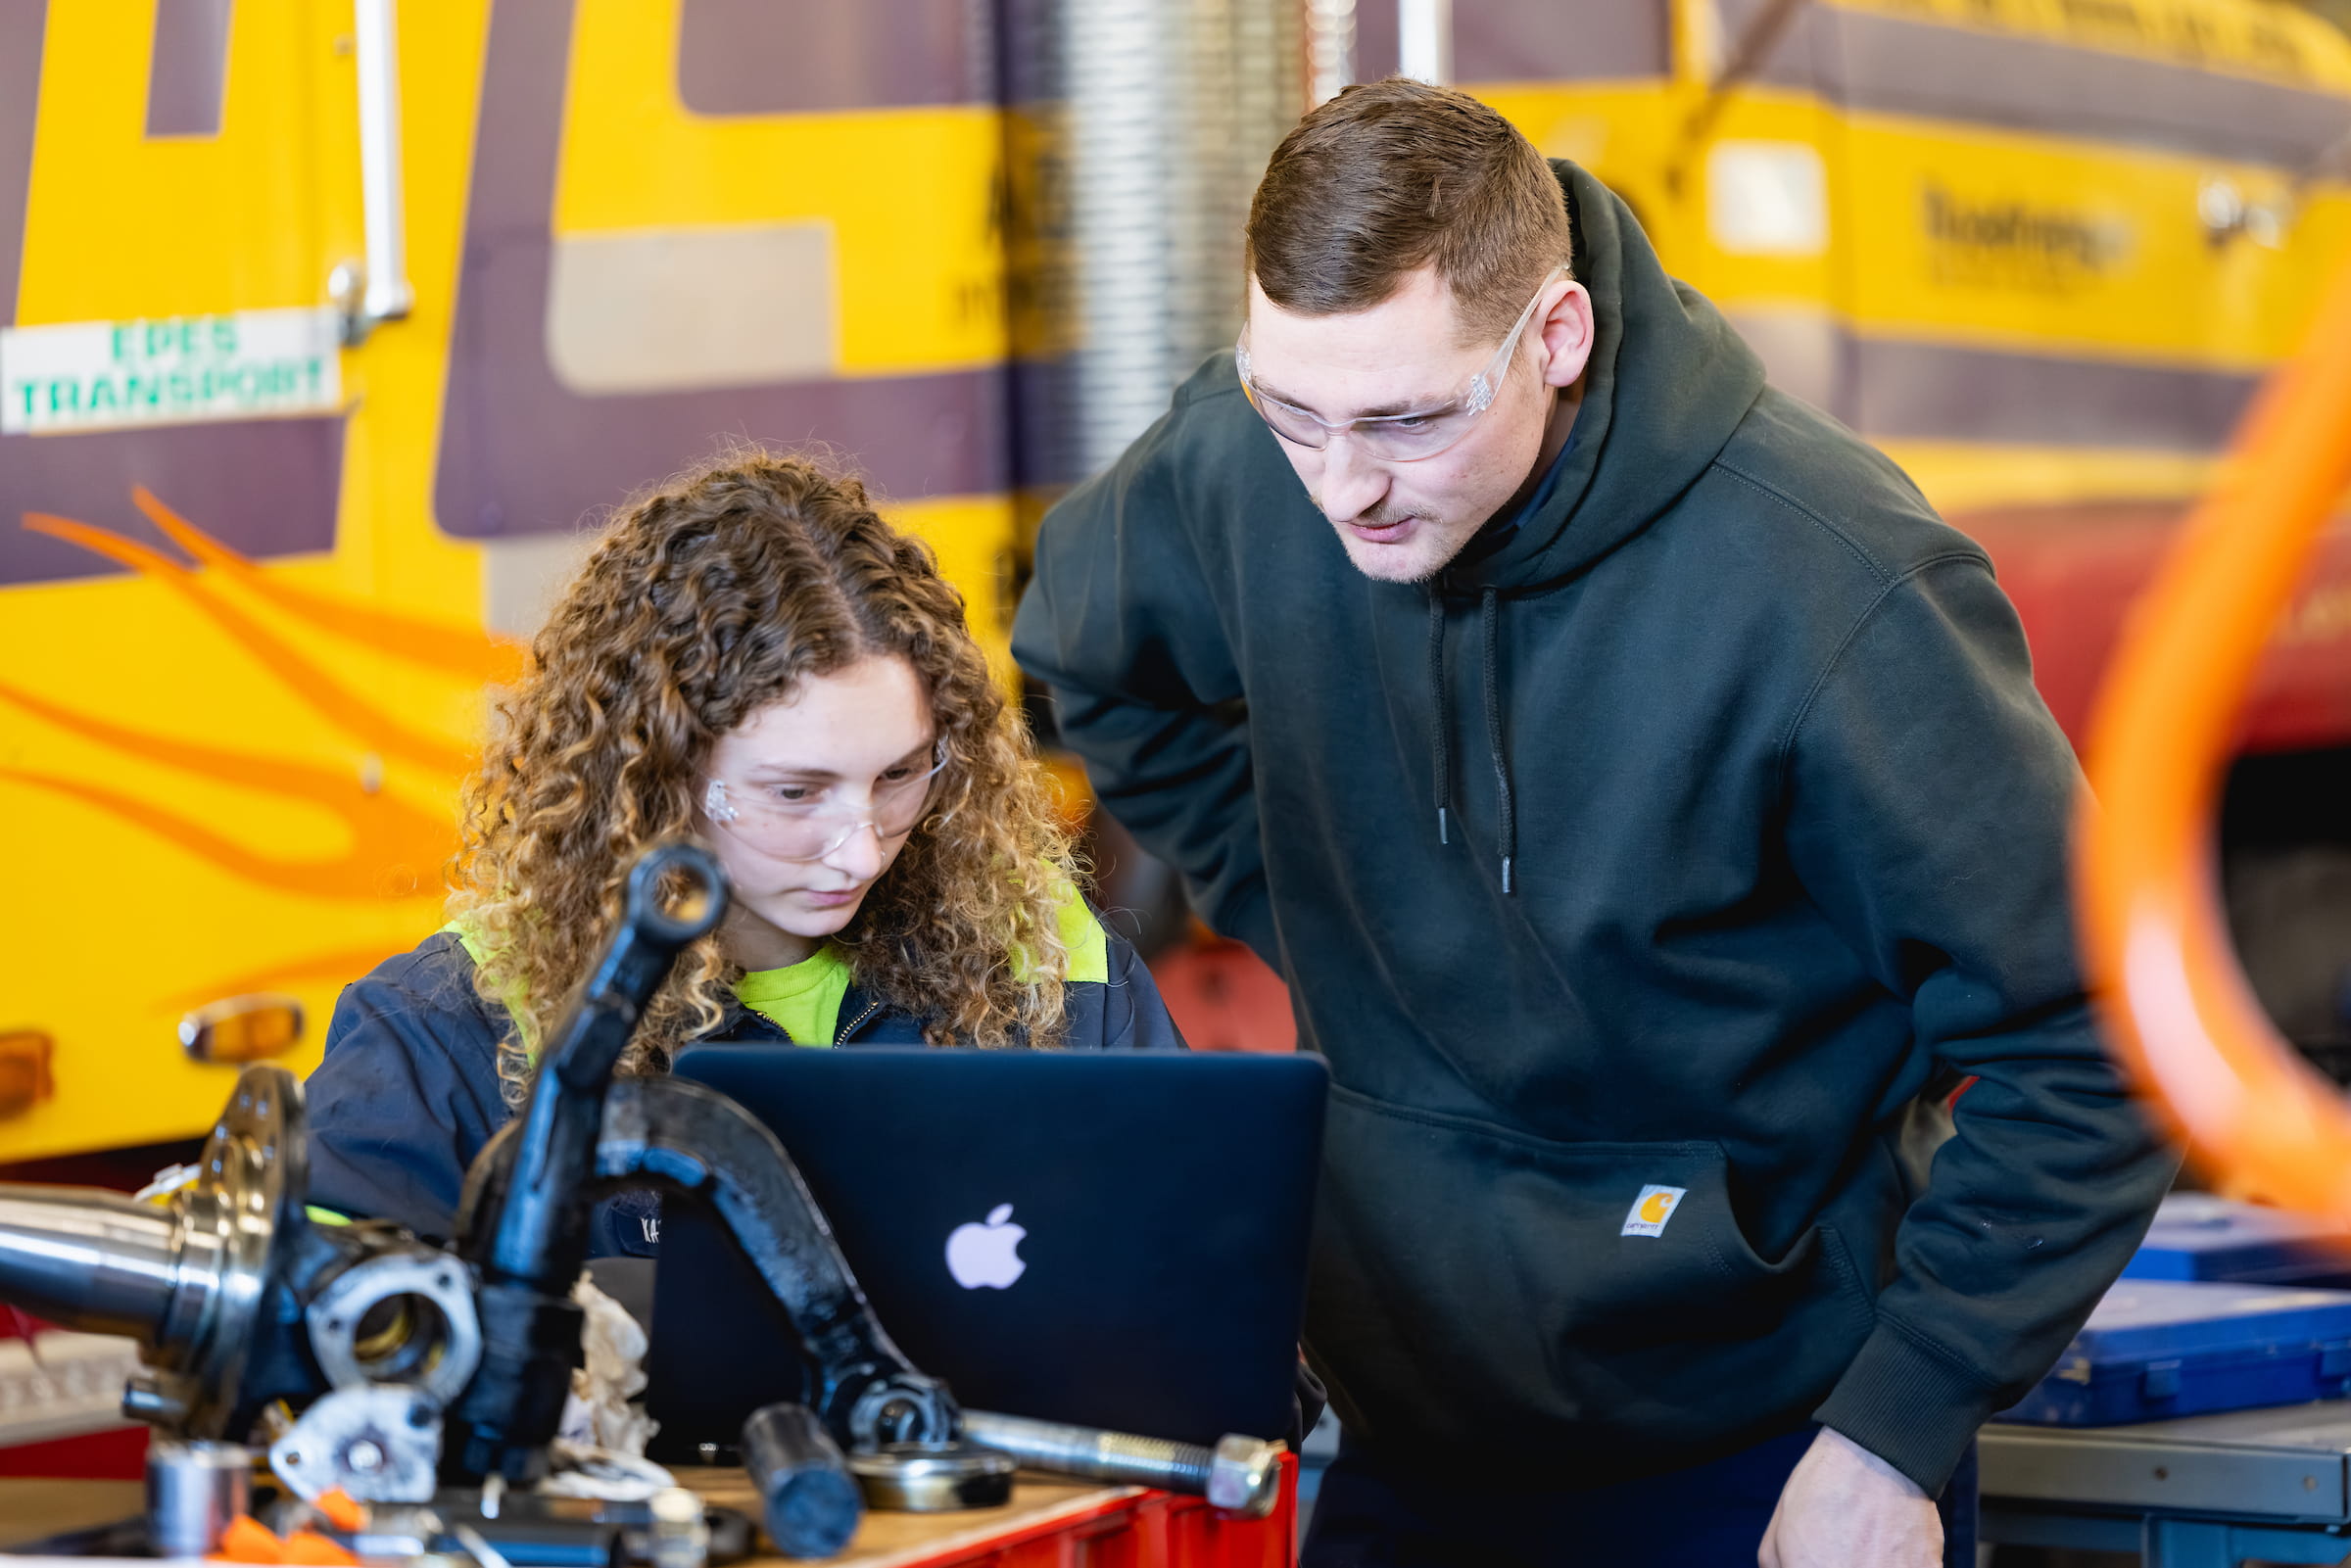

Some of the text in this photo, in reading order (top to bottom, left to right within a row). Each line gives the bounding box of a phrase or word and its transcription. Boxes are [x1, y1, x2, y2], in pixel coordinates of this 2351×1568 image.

[111, 317, 238, 360] EPES
[17, 356, 323, 418] TRANSPORT
[640, 1217, 661, 1243] KA
